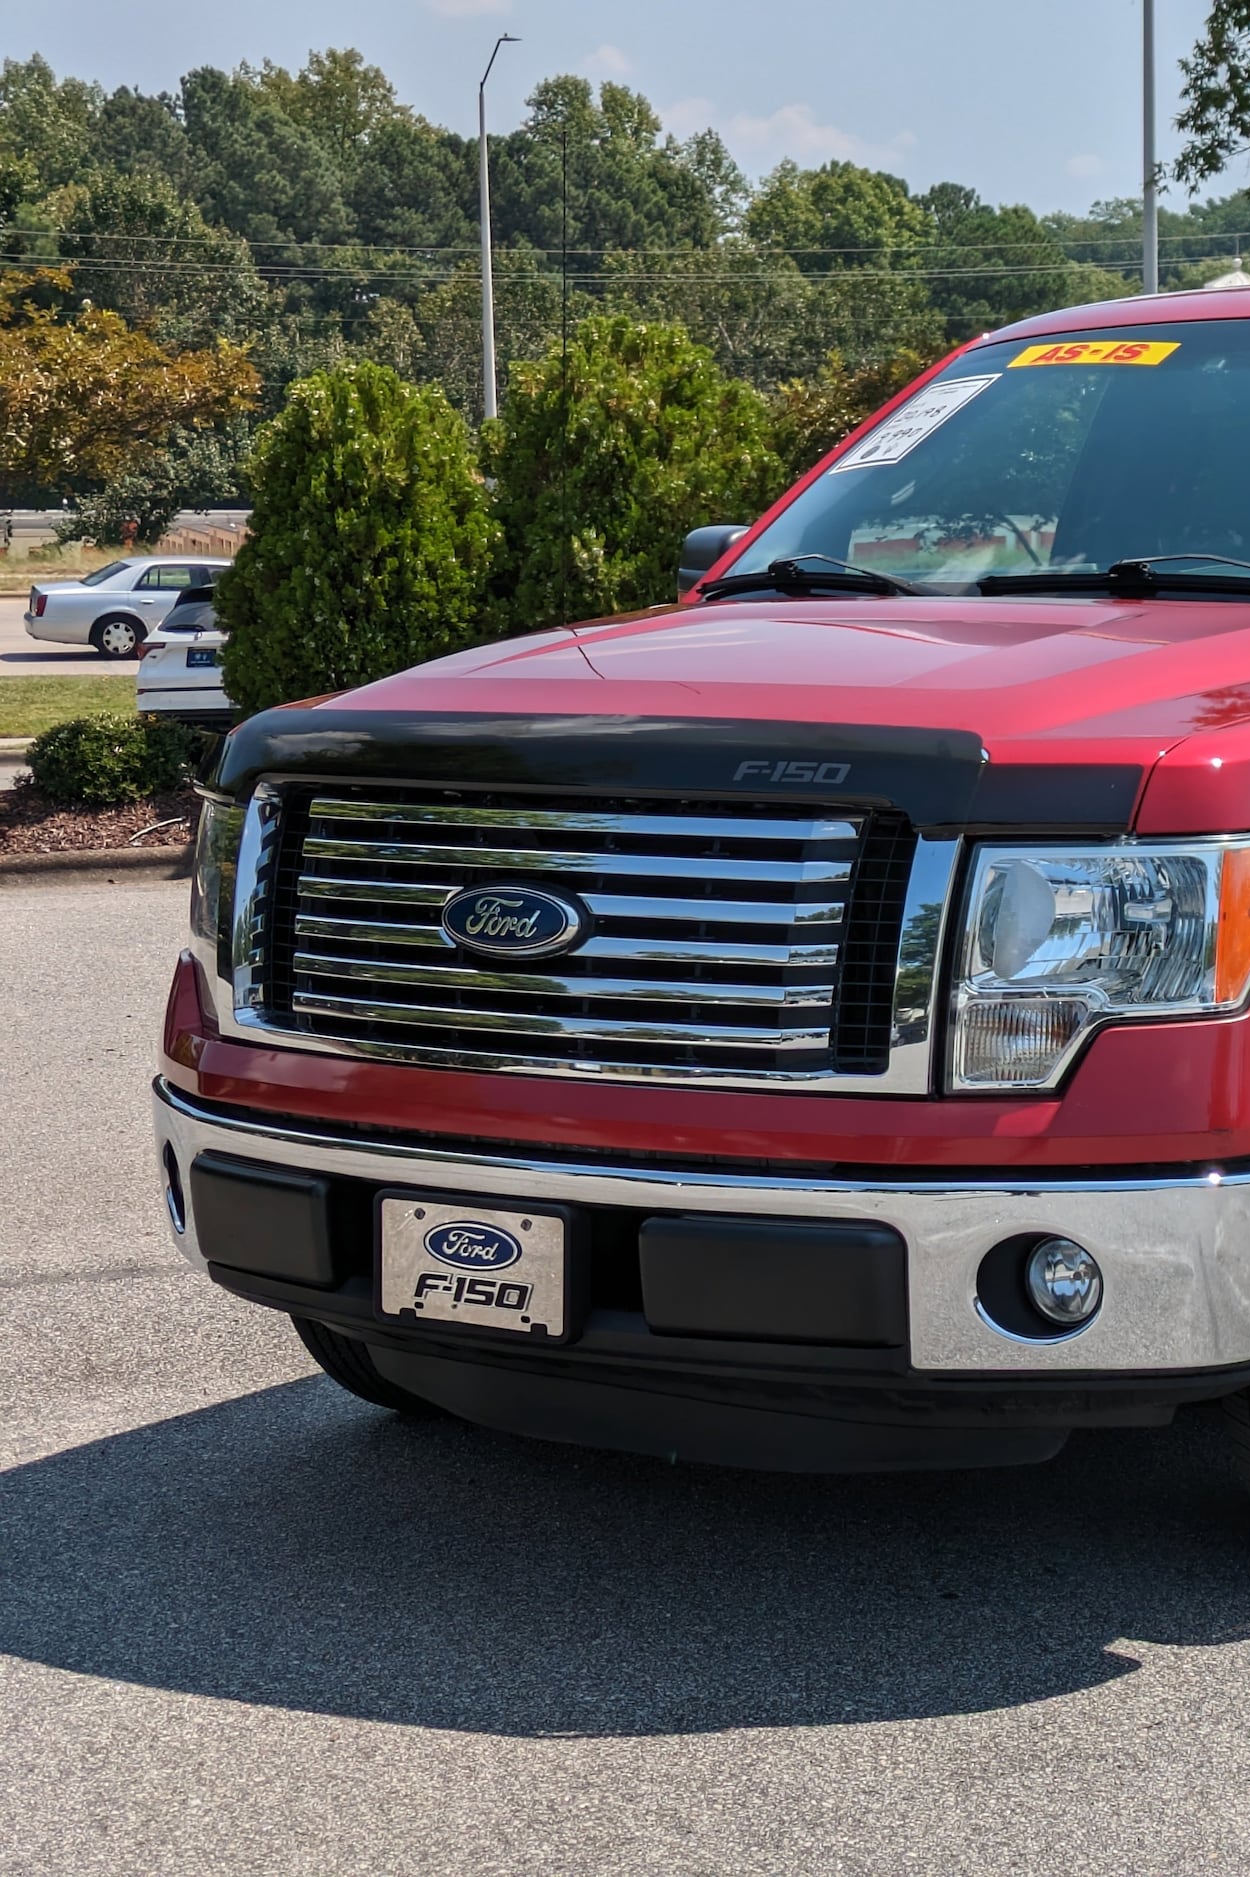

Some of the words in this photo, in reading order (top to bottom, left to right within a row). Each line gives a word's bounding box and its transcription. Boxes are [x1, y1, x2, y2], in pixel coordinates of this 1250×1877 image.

[733, 760, 852, 784] F-150
[465, 896, 542, 938] Ford
[442, 1229, 501, 1261] Ford
[414, 1271, 534, 1313] F-150
